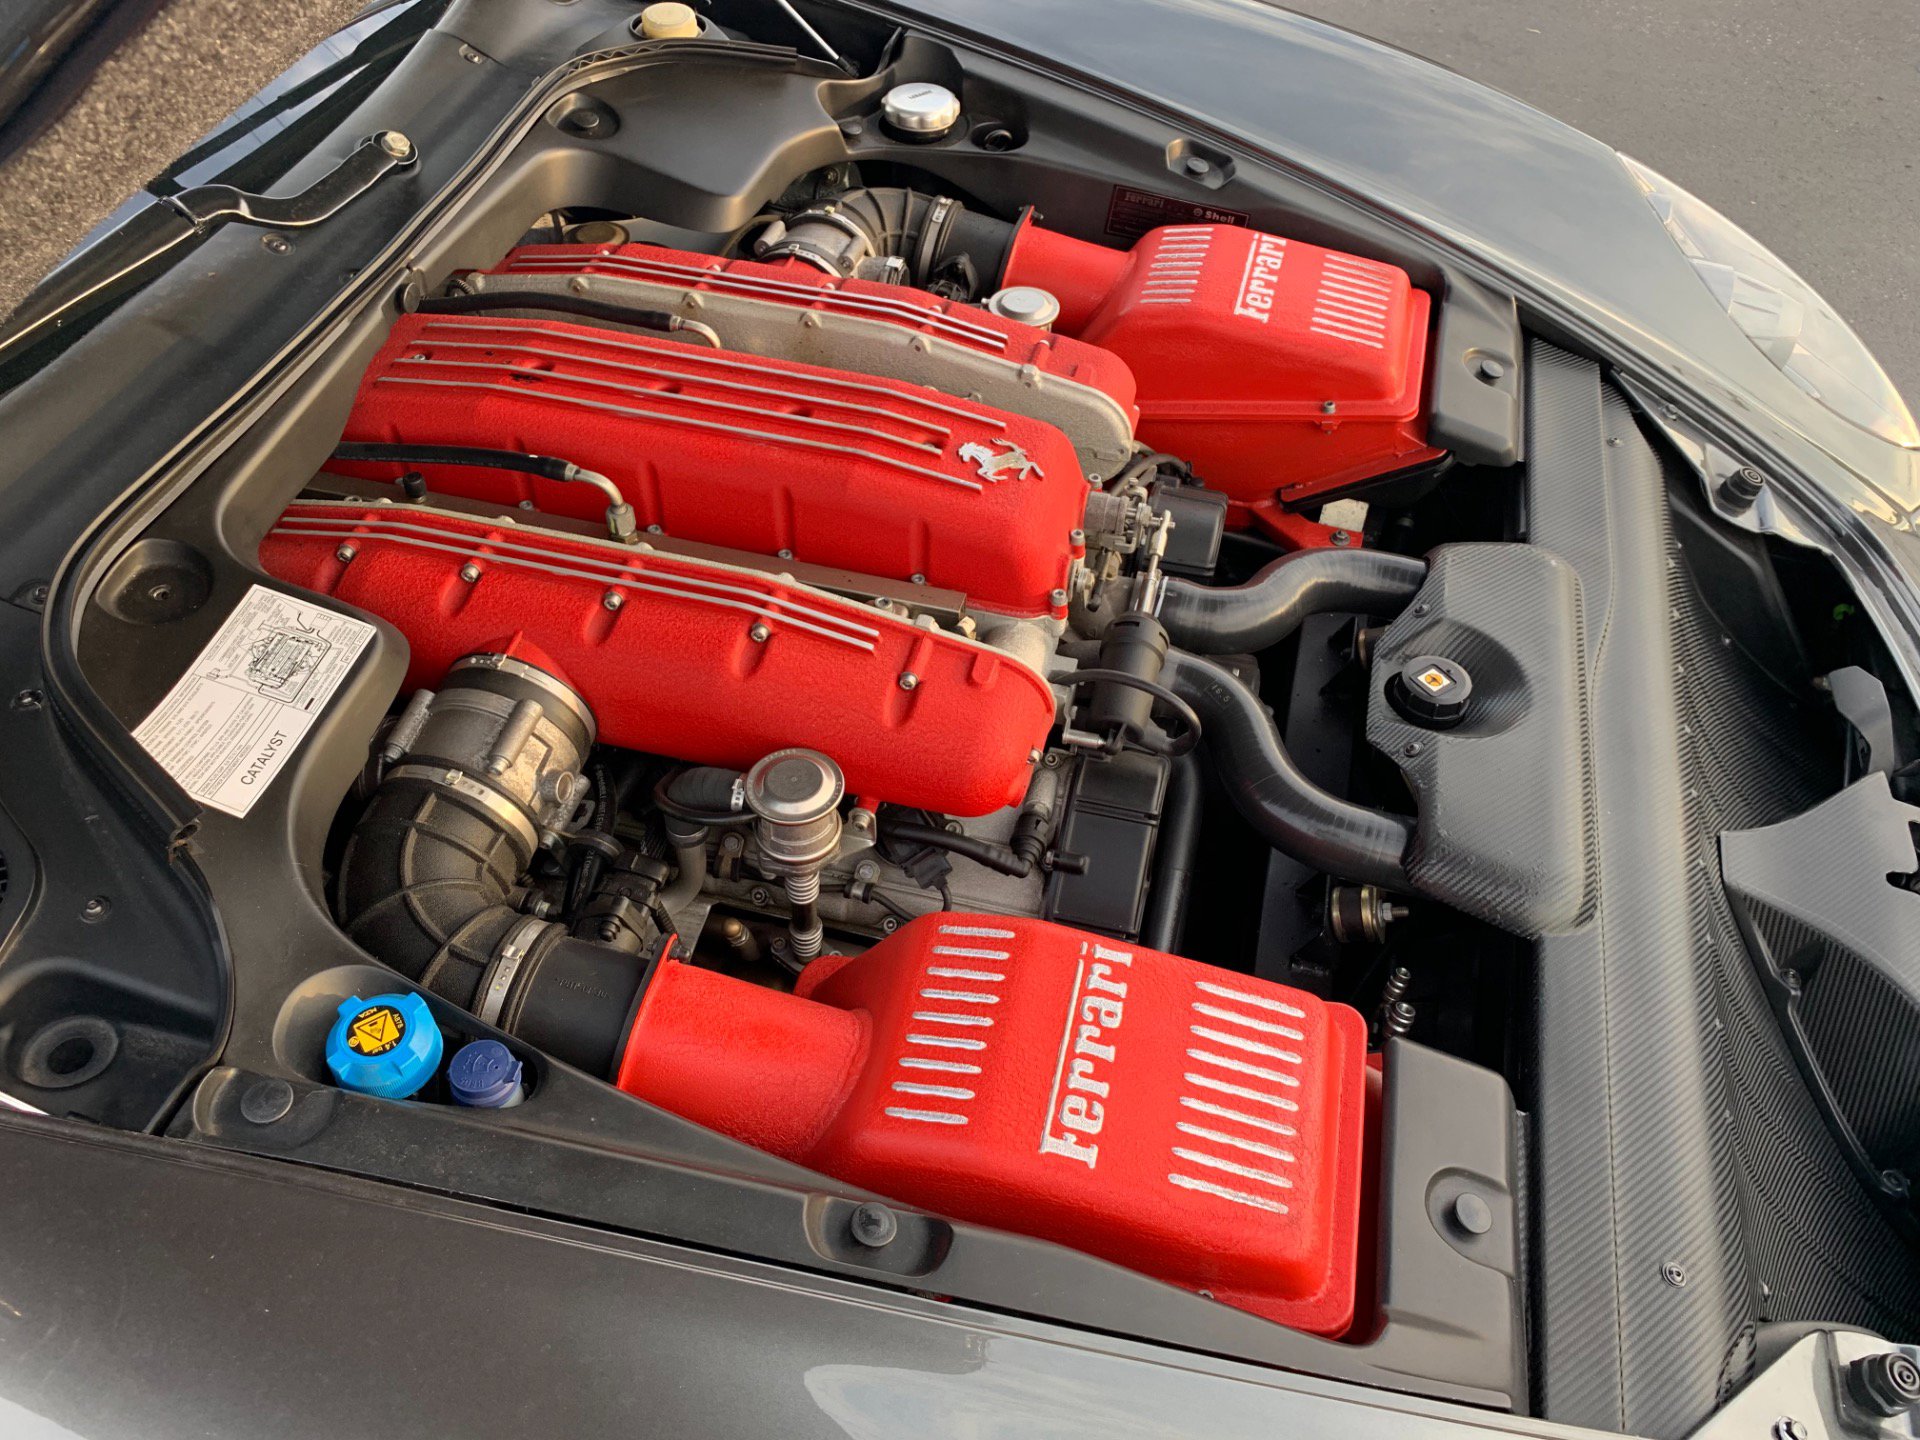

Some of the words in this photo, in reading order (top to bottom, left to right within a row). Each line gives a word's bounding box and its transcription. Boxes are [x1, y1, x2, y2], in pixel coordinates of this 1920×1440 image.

[1205, 210, 1235, 224] Shell
[1233, 231, 1287, 324] Ferrari
[240, 730, 287, 785] CATALYST
[1039, 942, 1133, 1169] Ferrari
